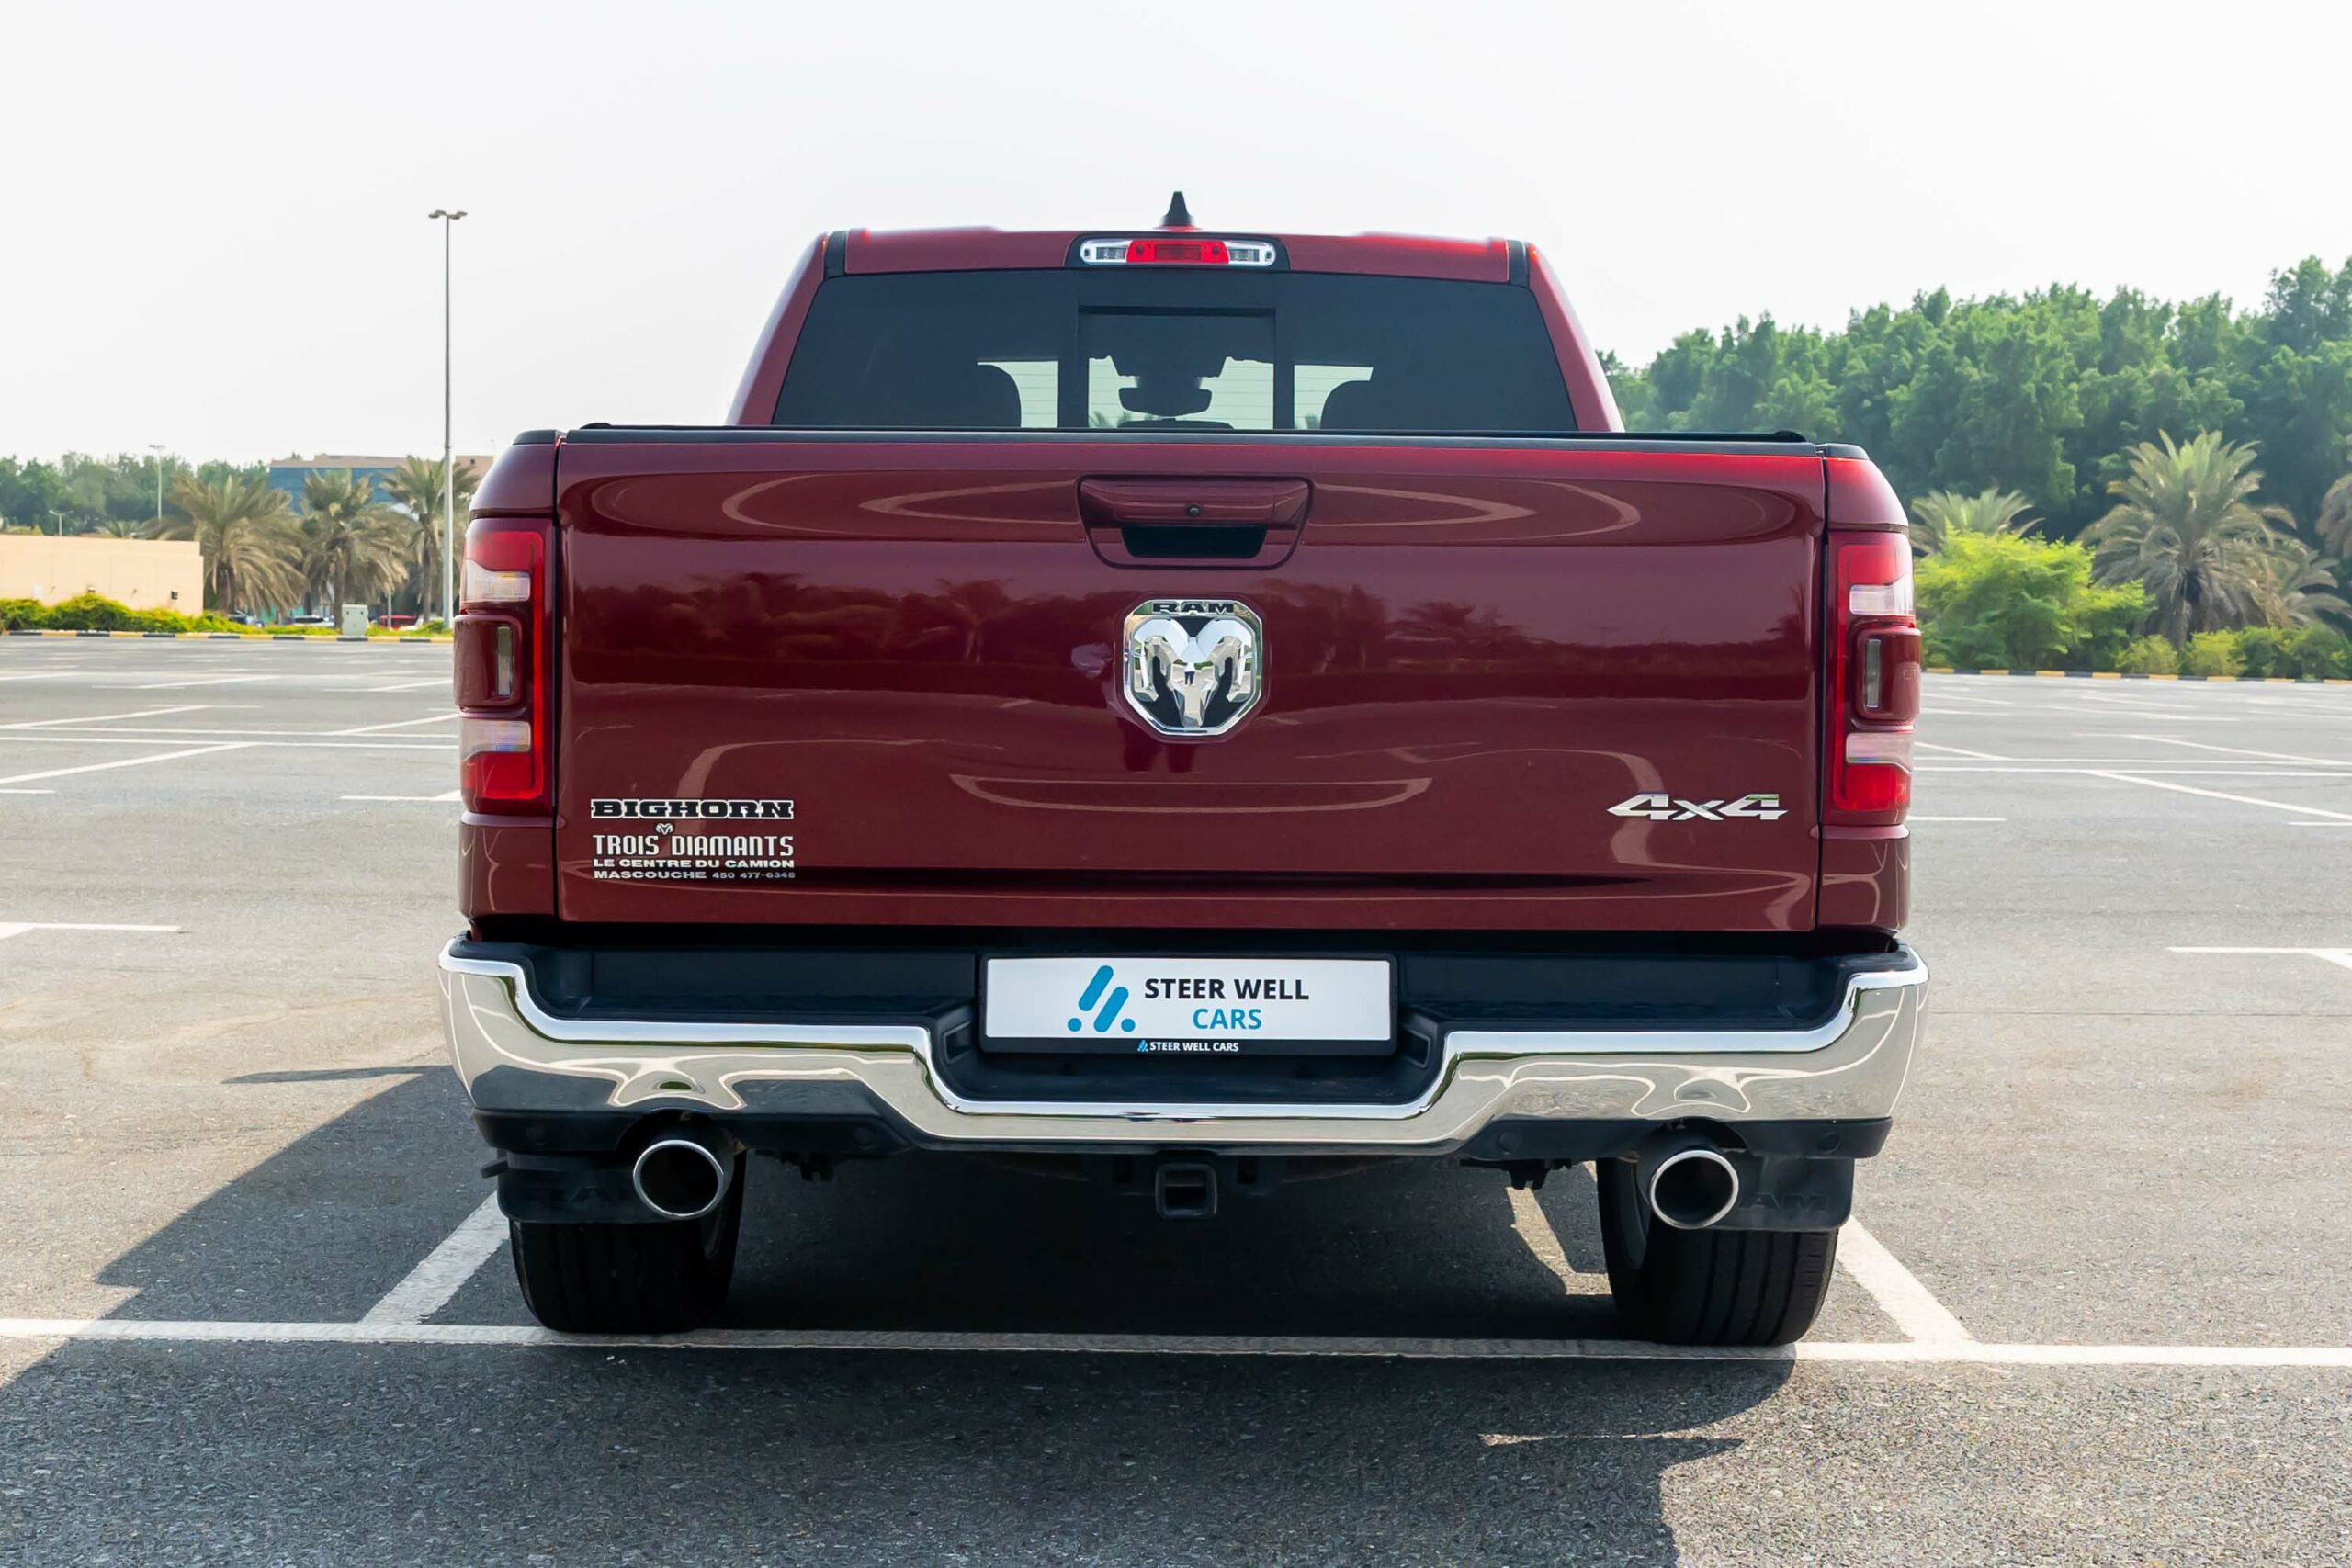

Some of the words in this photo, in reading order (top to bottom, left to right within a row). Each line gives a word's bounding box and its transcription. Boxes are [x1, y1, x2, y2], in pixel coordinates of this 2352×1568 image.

[1152, 602, 1234, 614] RAM
[591, 799, 794, 819] BIGHORN
[593, 834, 659, 855] TROIS
[672, 835, 794, 856] DIAMANTS
[594, 859, 615, 867] LE
[619, 859, 692, 868] CENTRE
[695, 860, 720, 868] DU
[725, 860, 795, 869] CAMION
[594, 871, 707, 879] MASCOUCHE
[1145, 978, 1226, 999] STEER
[1234, 978, 1309, 999] WELL
[1193, 1008, 1261, 1030] CARS
[1149, 1042, 1180, 1051] STEER
[1182, 1043, 1211, 1052] WELL
[1213, 1043, 1239, 1052] CARS
[1738, 1191, 1826, 1211] AM
